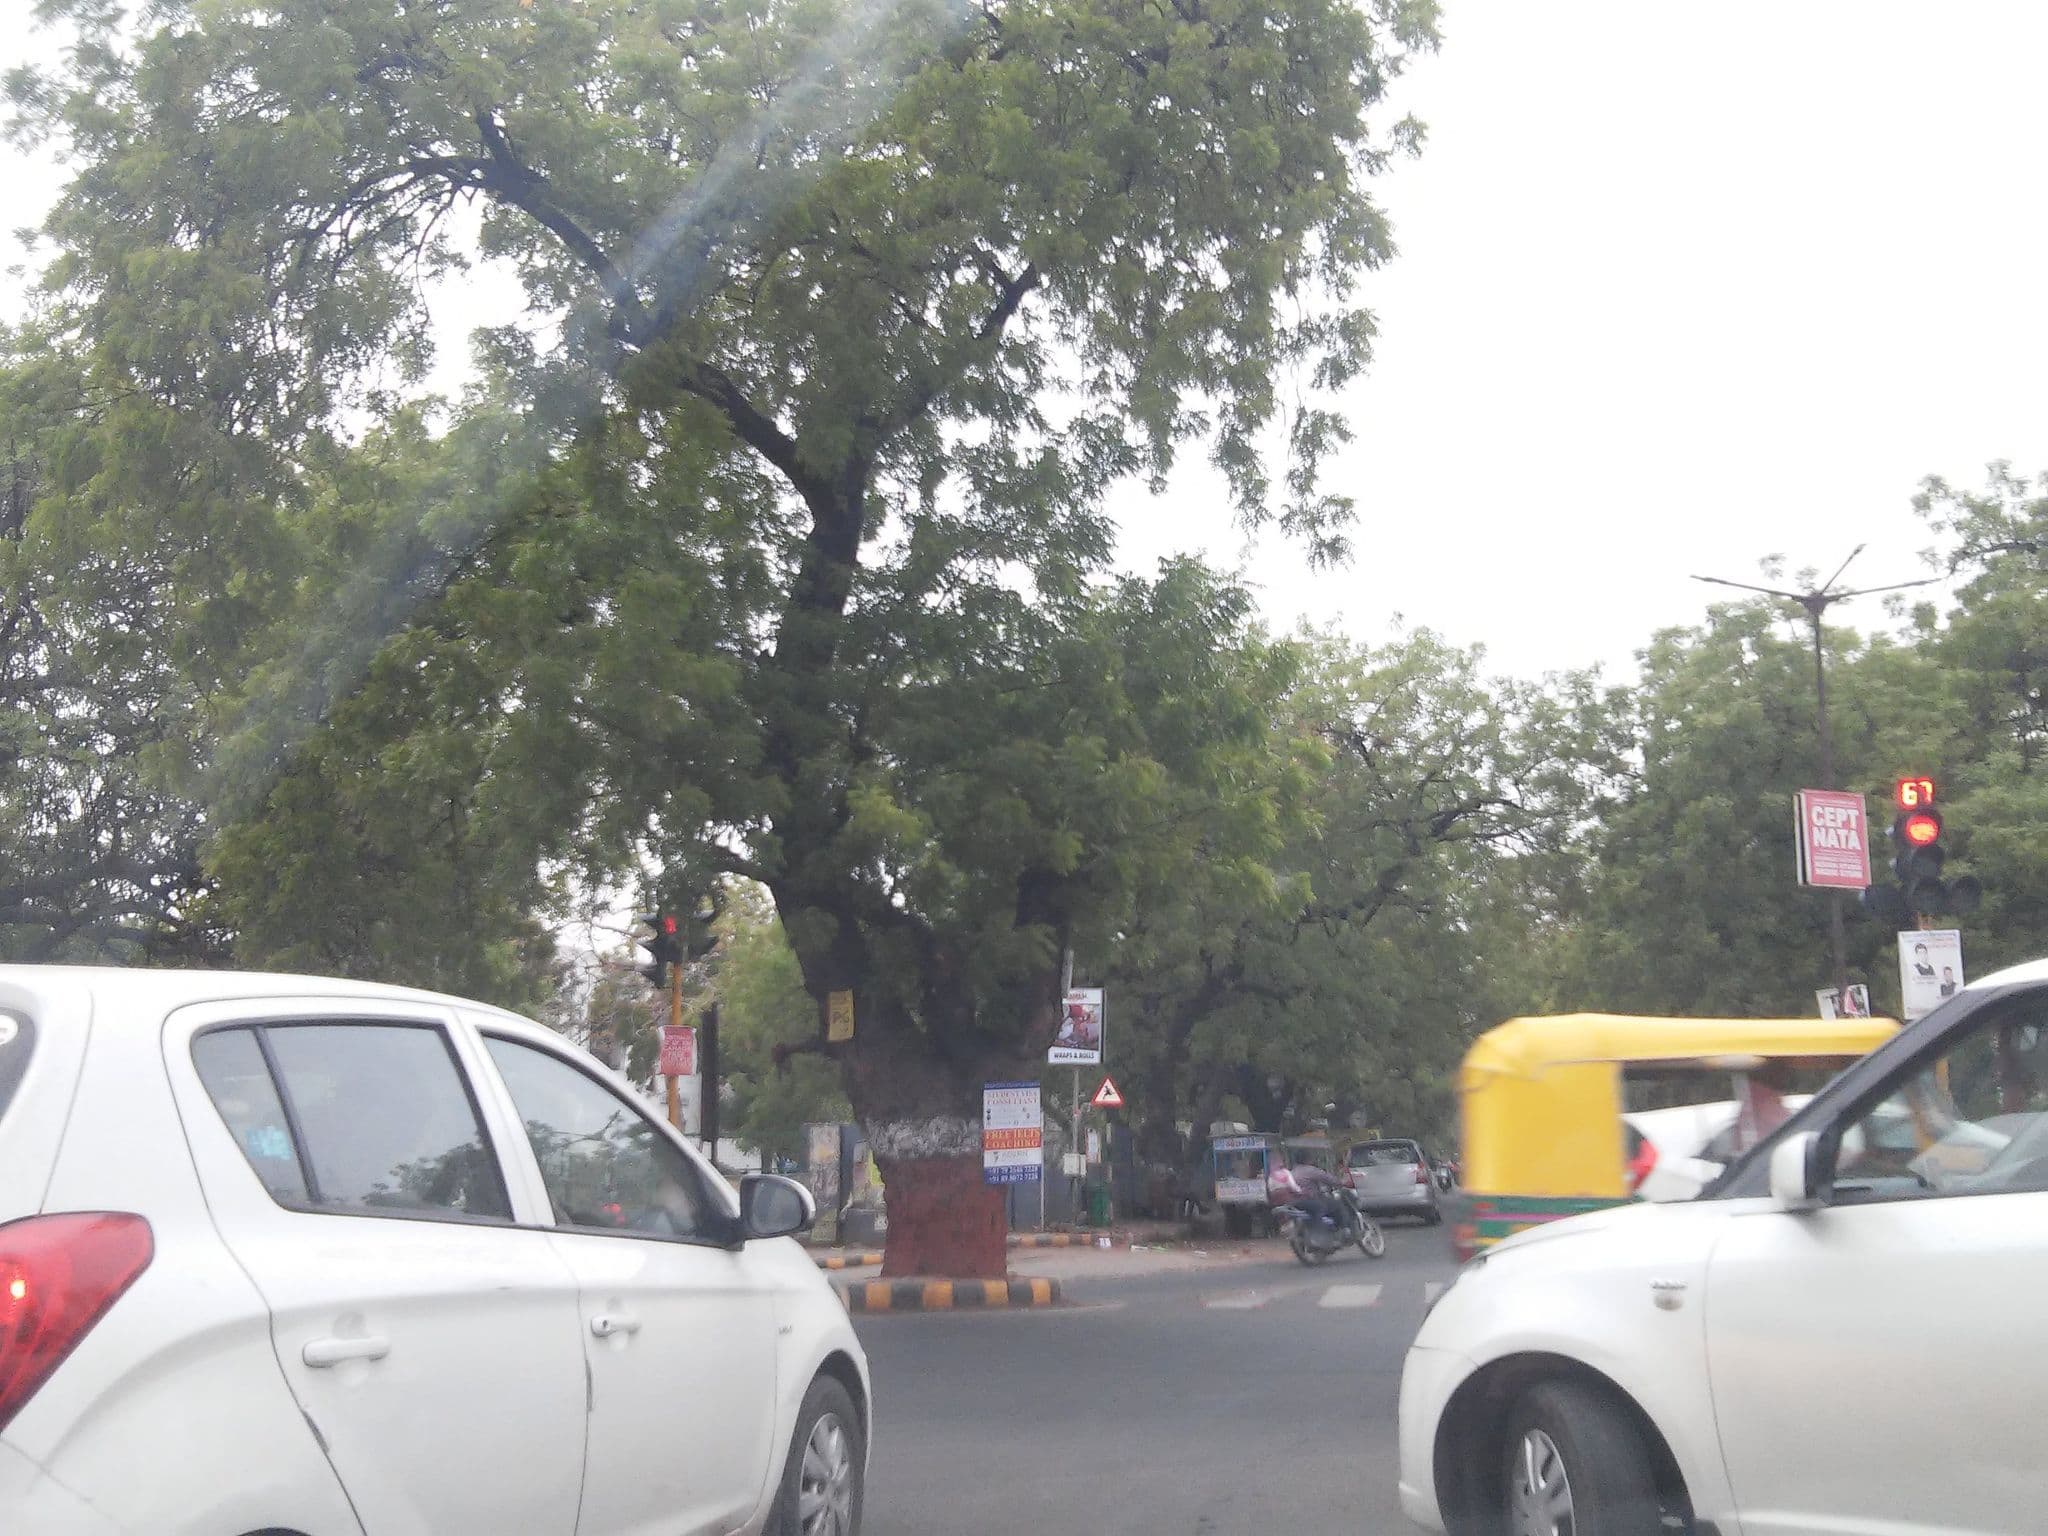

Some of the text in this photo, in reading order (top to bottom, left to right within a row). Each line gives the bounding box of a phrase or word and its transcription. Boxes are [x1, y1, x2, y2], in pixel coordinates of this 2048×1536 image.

[1812, 805, 1859, 830] CEPT
[1812, 826, 1861, 850] NATA
[1054, 1051, 1072, 1059] WRAPS
[985, 1128, 1040, 1139] FREE IELTS
[985, 1138, 1039, 1148] COACHING
